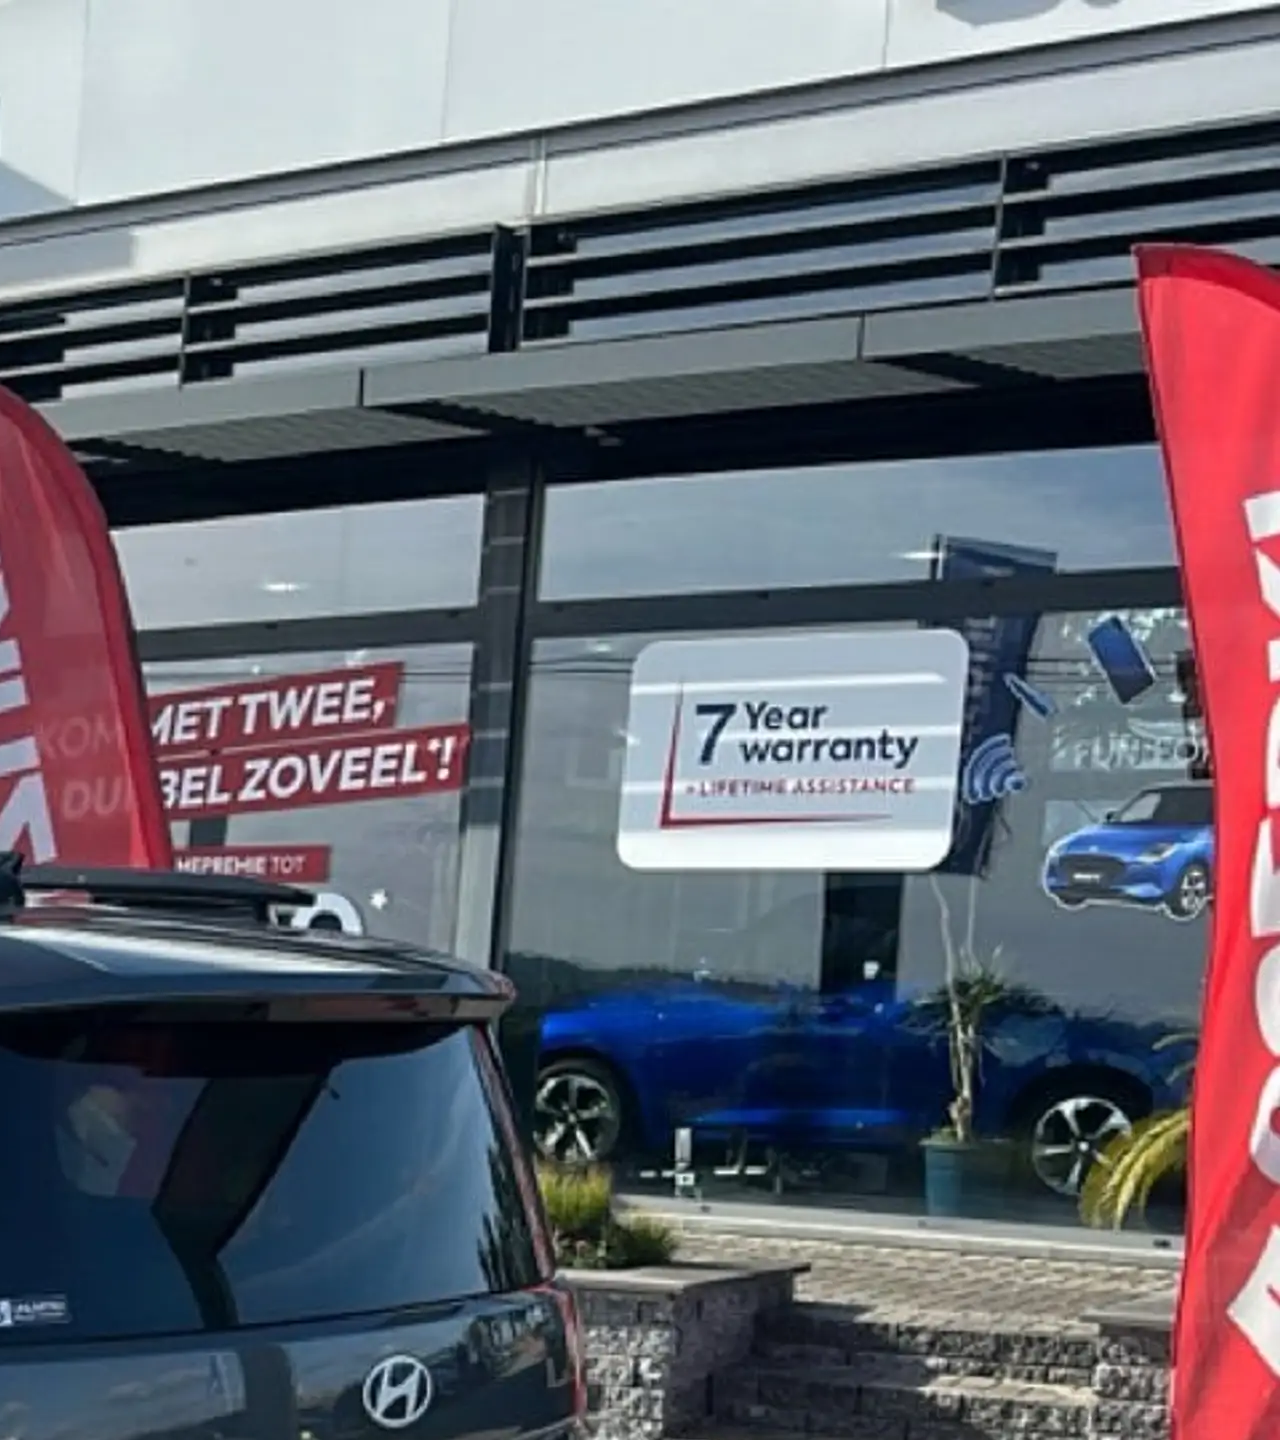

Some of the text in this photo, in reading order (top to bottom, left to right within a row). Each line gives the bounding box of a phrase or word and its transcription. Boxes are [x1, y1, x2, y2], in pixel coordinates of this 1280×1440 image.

[243, 679, 388, 736] TWEE,
[744, 701, 828, 730] Year
[695, 703, 737, 765] 7
[739, 730, 919, 769] warranty
[701, 779, 786, 798] LIFETIME
[791, 778, 916, 796] ASSISTANCE
[269, 855, 306, 873] TOT
